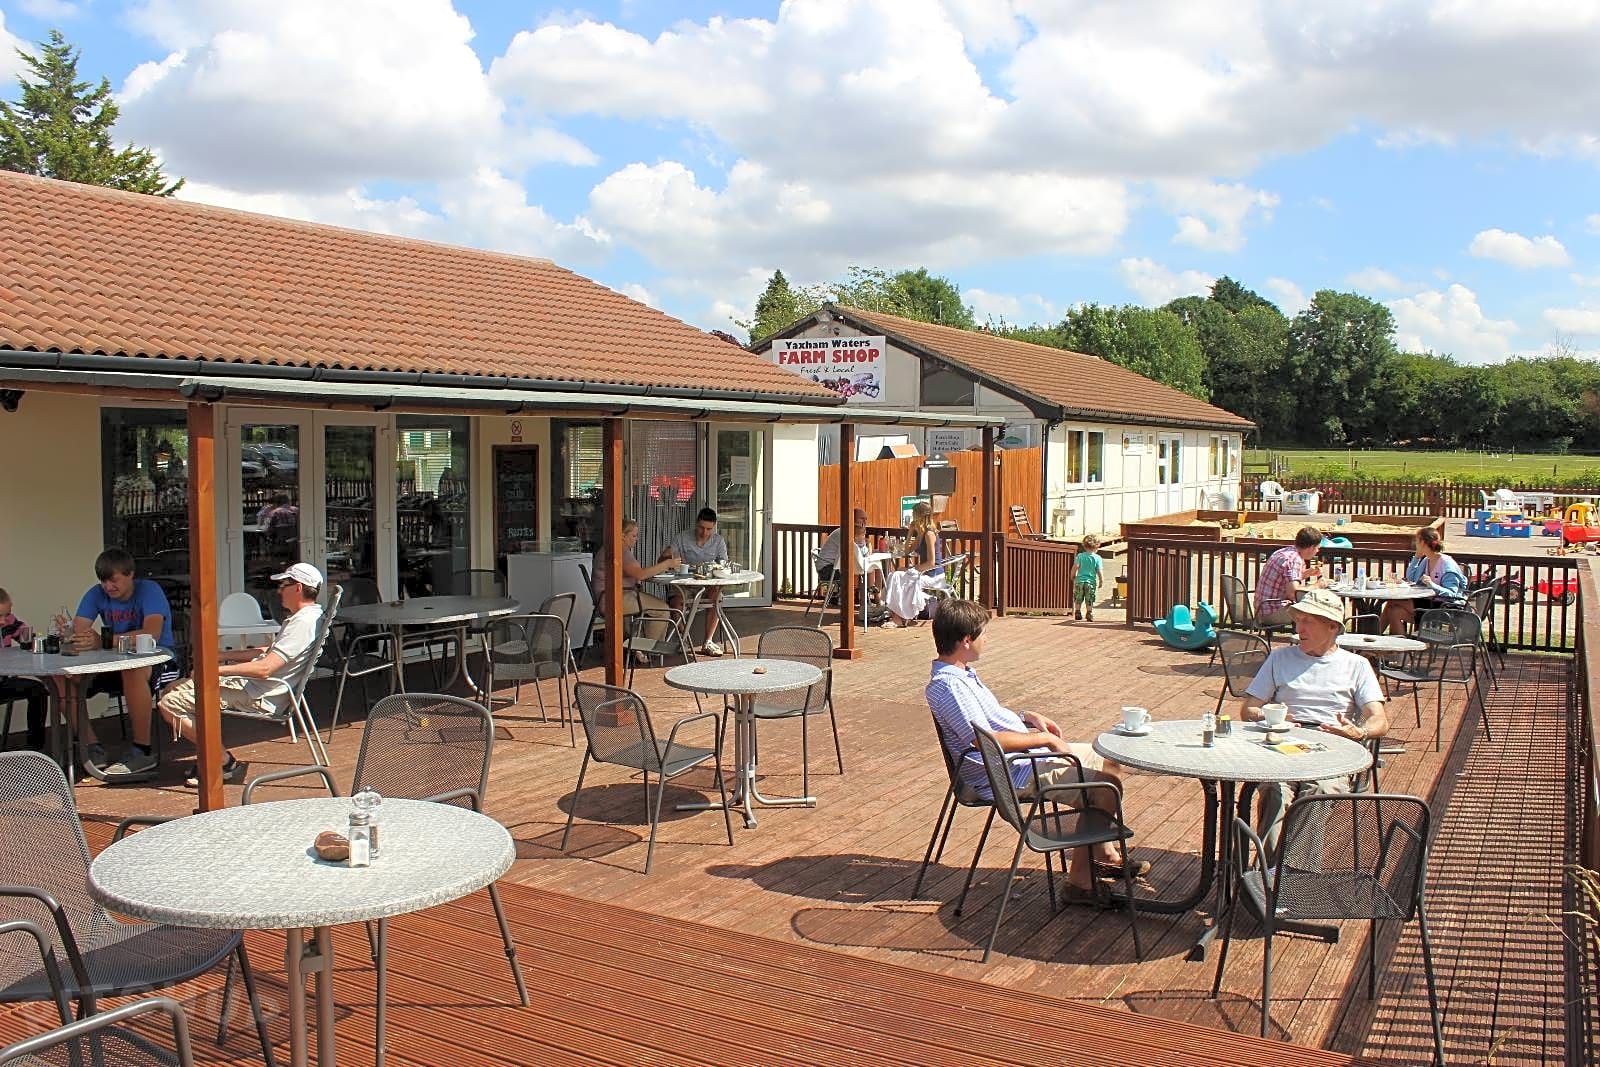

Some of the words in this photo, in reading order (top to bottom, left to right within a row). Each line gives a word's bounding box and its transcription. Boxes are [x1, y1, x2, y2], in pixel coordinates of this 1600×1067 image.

[785, 341, 829, 349] Yaxham
[831, 339, 871, 347] Waters
[779, 350, 826, 364] FARM
[832, 348, 880, 363] SHOP
[832, 365, 855, 373] Local
